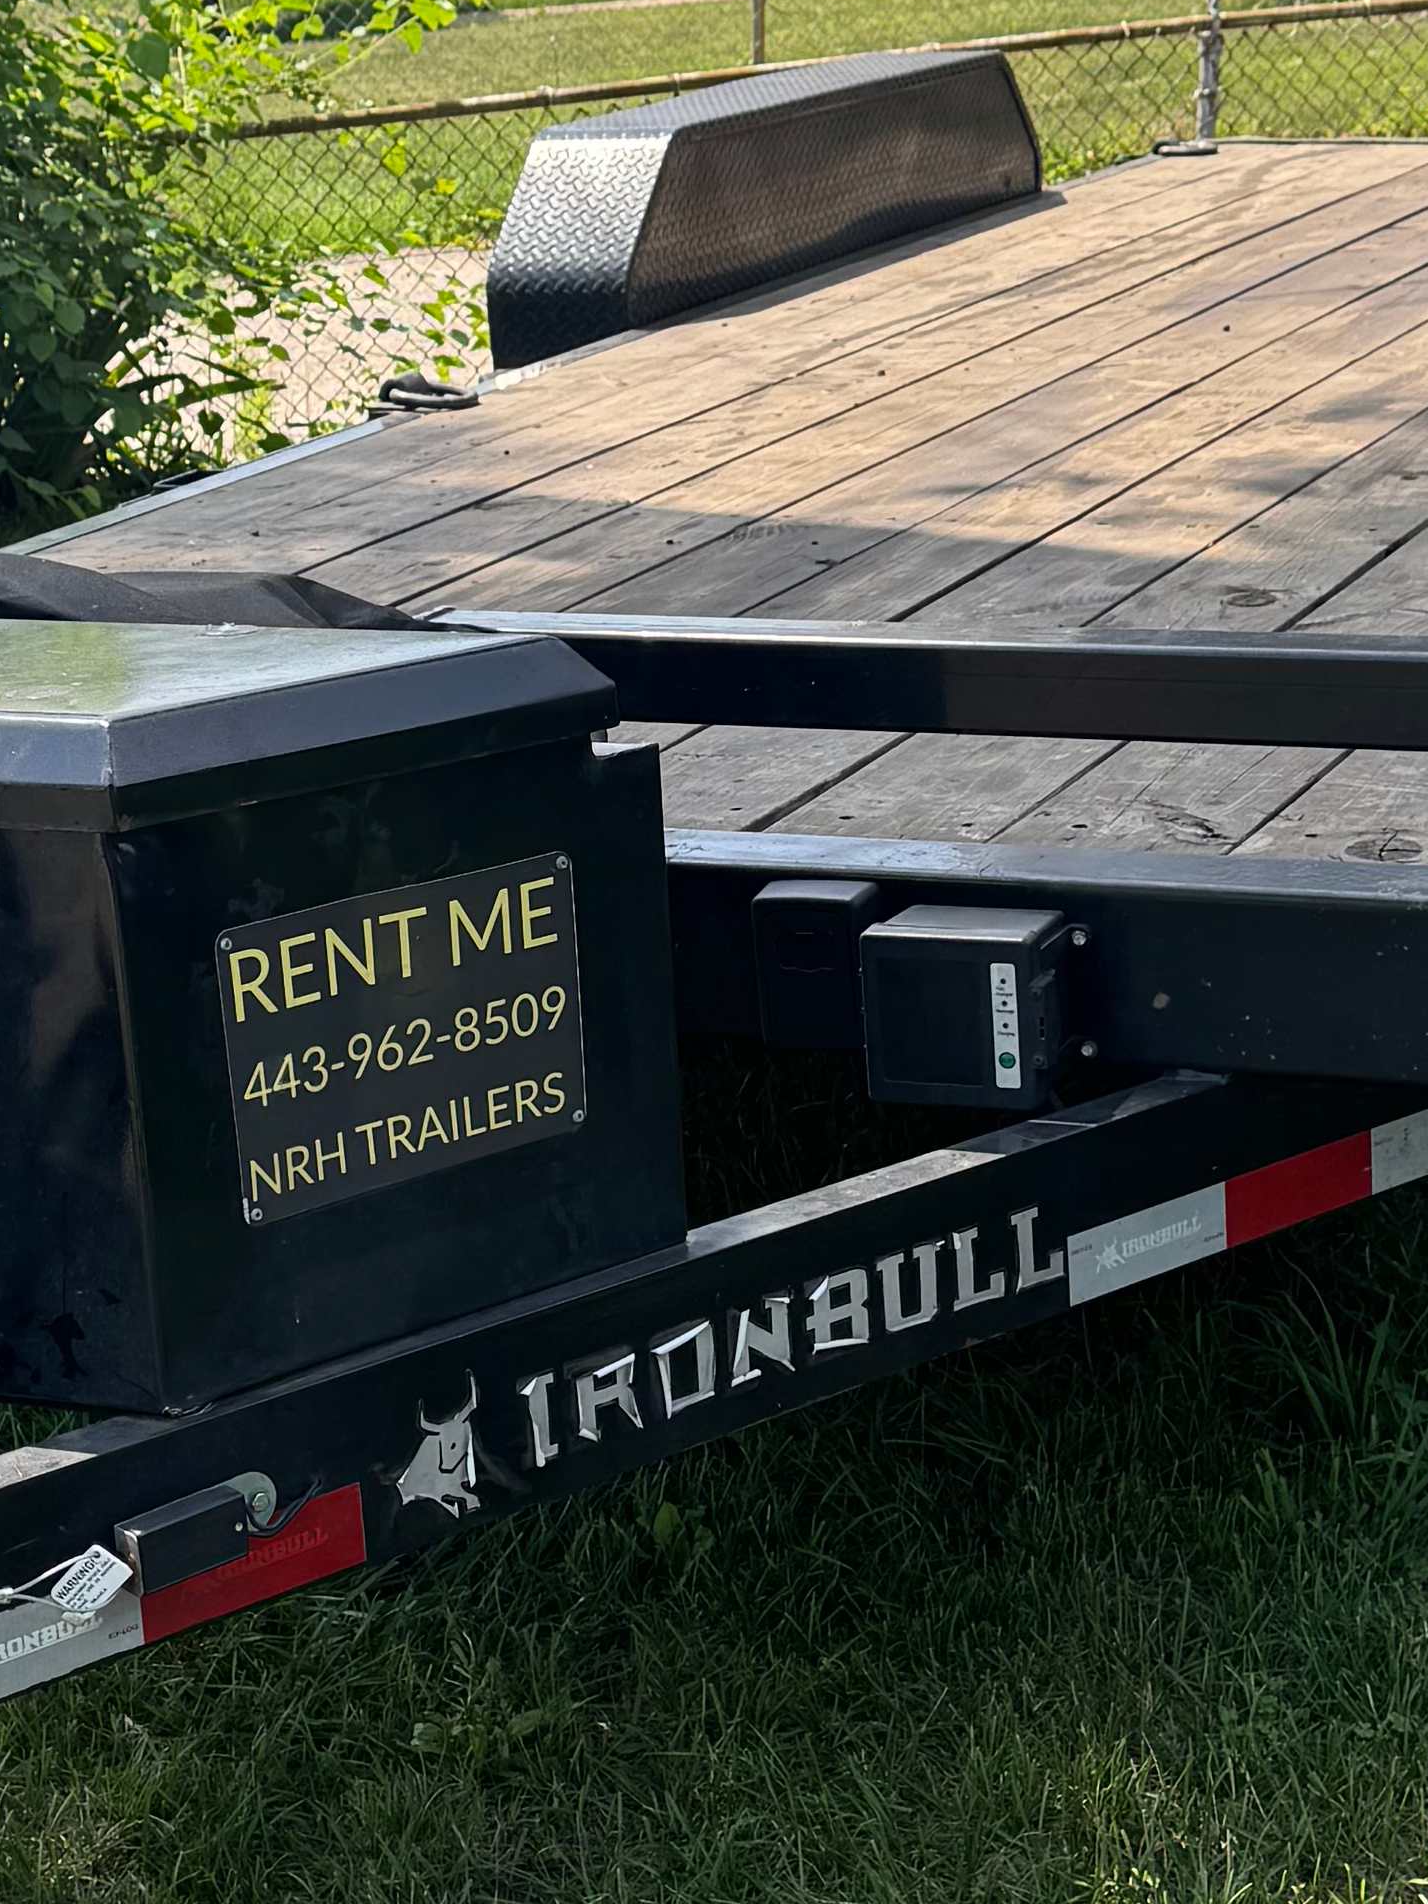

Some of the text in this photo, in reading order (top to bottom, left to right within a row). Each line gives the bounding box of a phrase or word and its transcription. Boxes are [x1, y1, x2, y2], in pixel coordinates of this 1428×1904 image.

[229, 877, 558, 1023] RENT ME
[243, 985, 566, 1107] 443-962-8509
[249, 1072, 565, 1202] NRH TRAILERS
[516, 1207, 1067, 1468] IRONBULL
